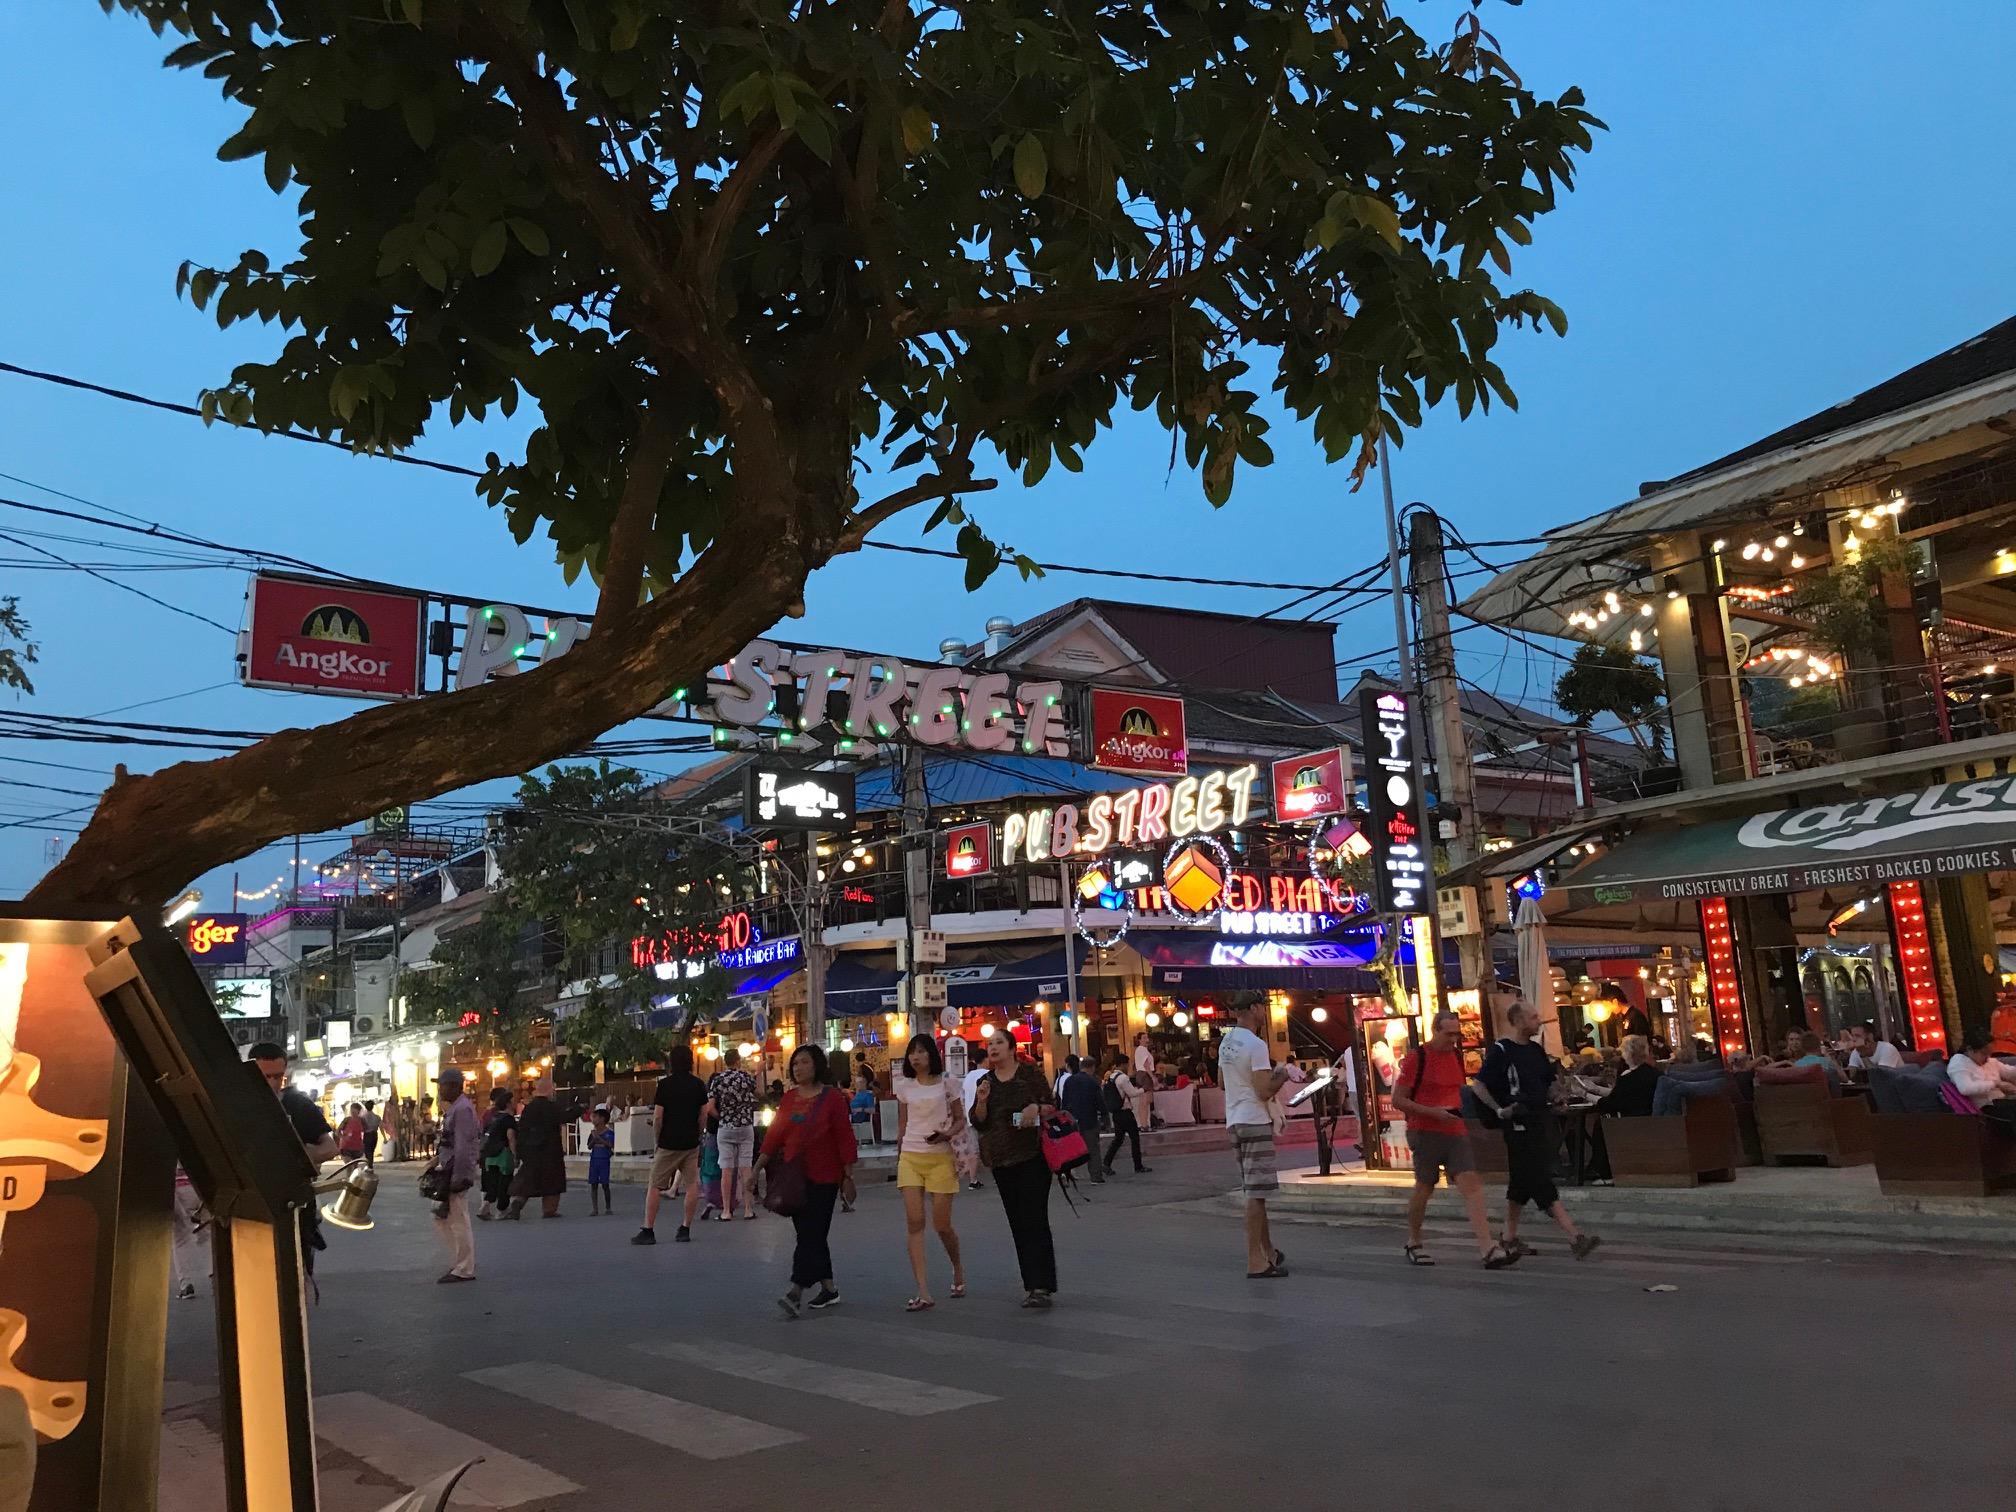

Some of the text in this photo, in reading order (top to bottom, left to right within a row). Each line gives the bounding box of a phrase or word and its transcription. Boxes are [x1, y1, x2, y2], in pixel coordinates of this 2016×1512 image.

[274, 643, 392, 679] Angkor
[716, 638, 1064, 754] STREET
[1106, 738, 1171, 763] Angkor
[1003, 763, 1258, 866] PUB STREET
[1285, 792, 1332, 812] kor
[1737, 777, 2016, 850] Carls
[1594, 886, 1633, 904] Carlsberg
[1662, 877, 1746, 898] CONSISTENTLY
[1750, 873, 1789, 890] GREAT
[1804, 865, 1871, 886] FRESHEST
[1876, 858, 1932, 879] BACKED
[190, 919, 240, 953] iger
[777, 941, 796, 960] BAR
[1304, 949, 1355, 960] VISA
